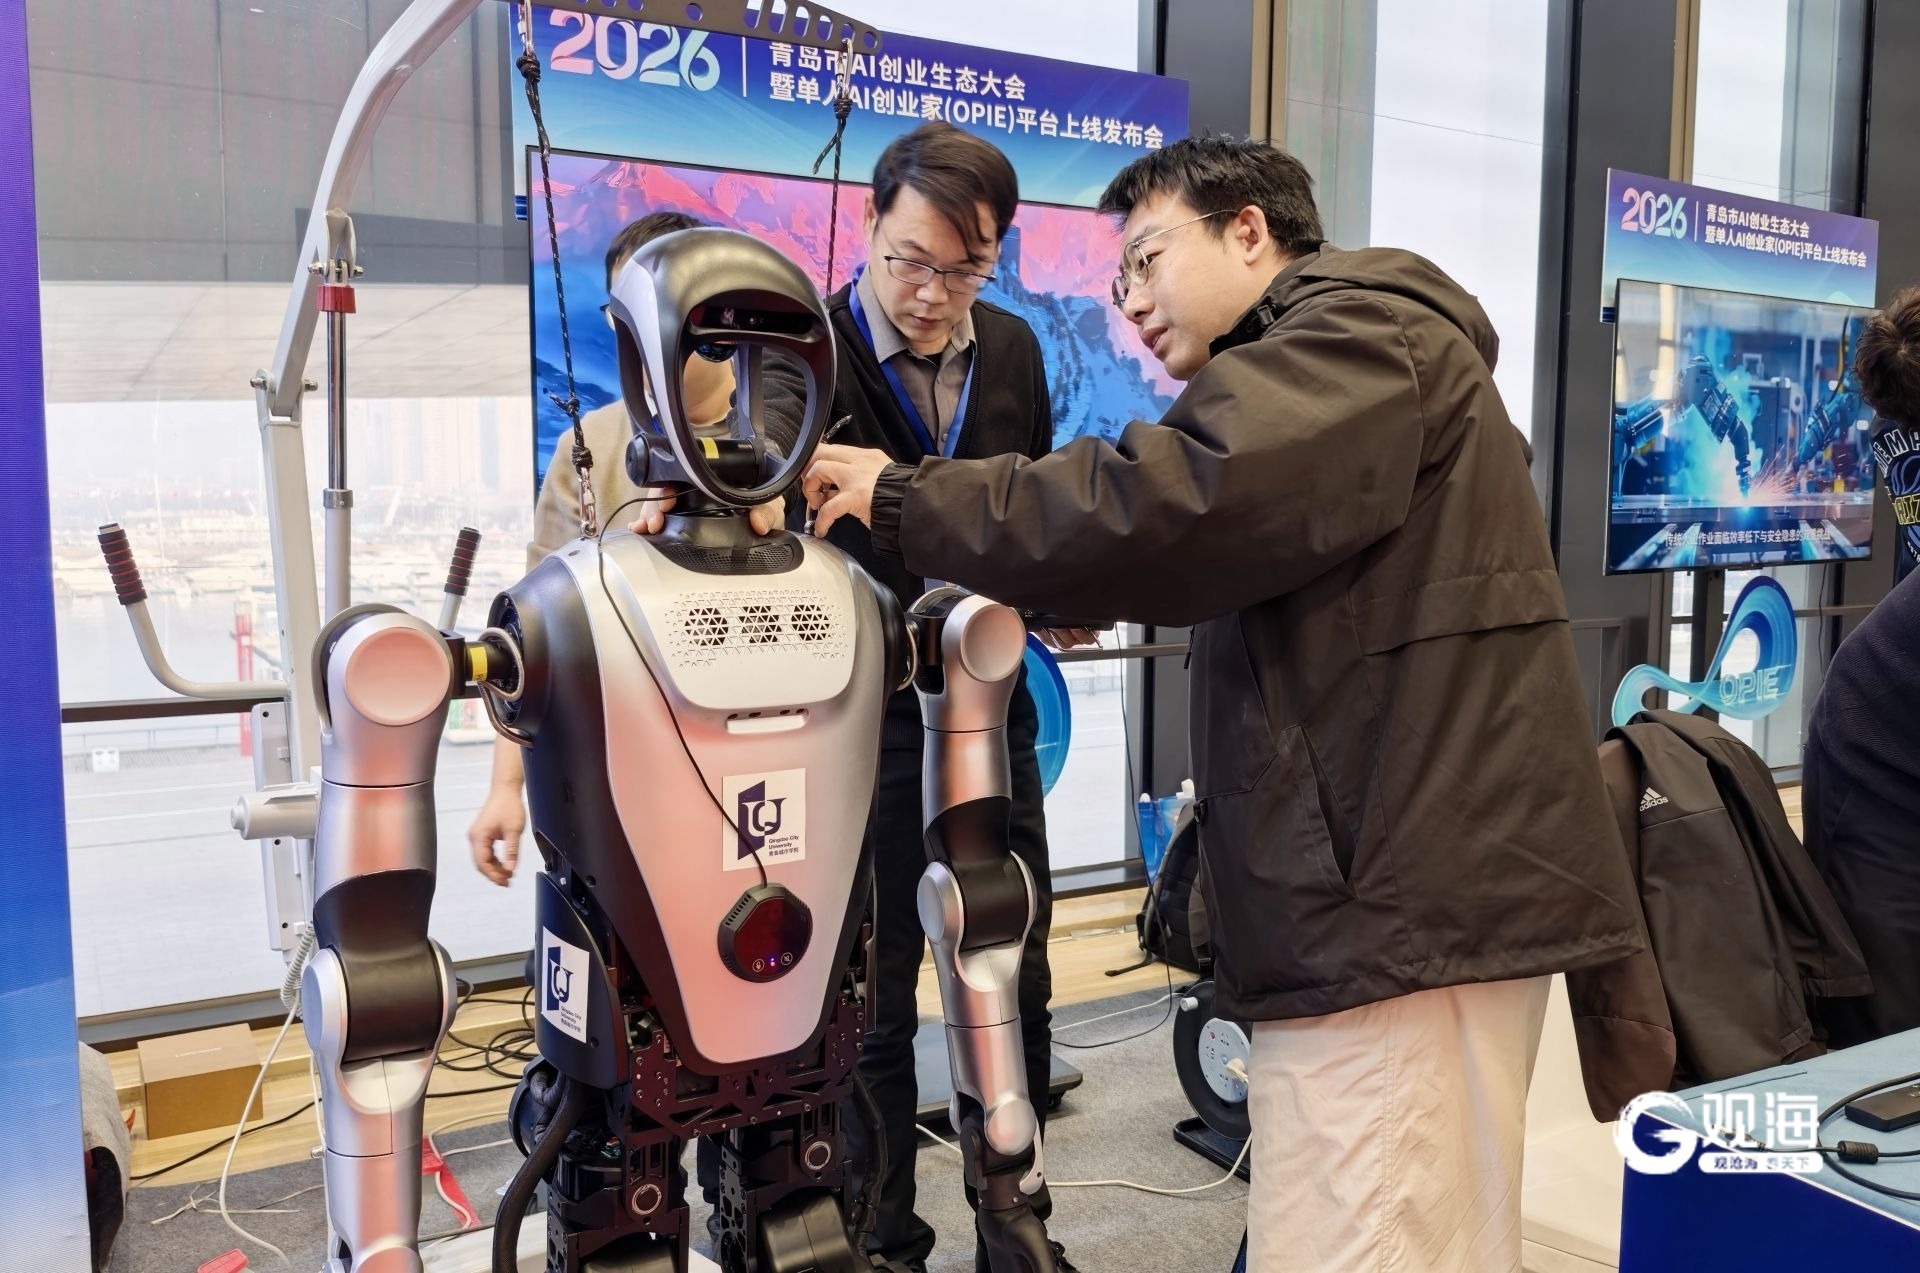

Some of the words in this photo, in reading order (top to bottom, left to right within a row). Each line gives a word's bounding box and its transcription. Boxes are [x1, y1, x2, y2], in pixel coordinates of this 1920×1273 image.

[549, 8, 721, 92] 2026
[1621, 186, 1688, 240] 2026
[1705, 203, 1810, 239] 青岛市AI创业生态大会
[1704, 226, 1868, 269] 暨单人AI创业家(OPIE)平台上线发布会
[1720, 667, 1780, 706] OPIE
[1640, 796, 1669, 812] adidas
